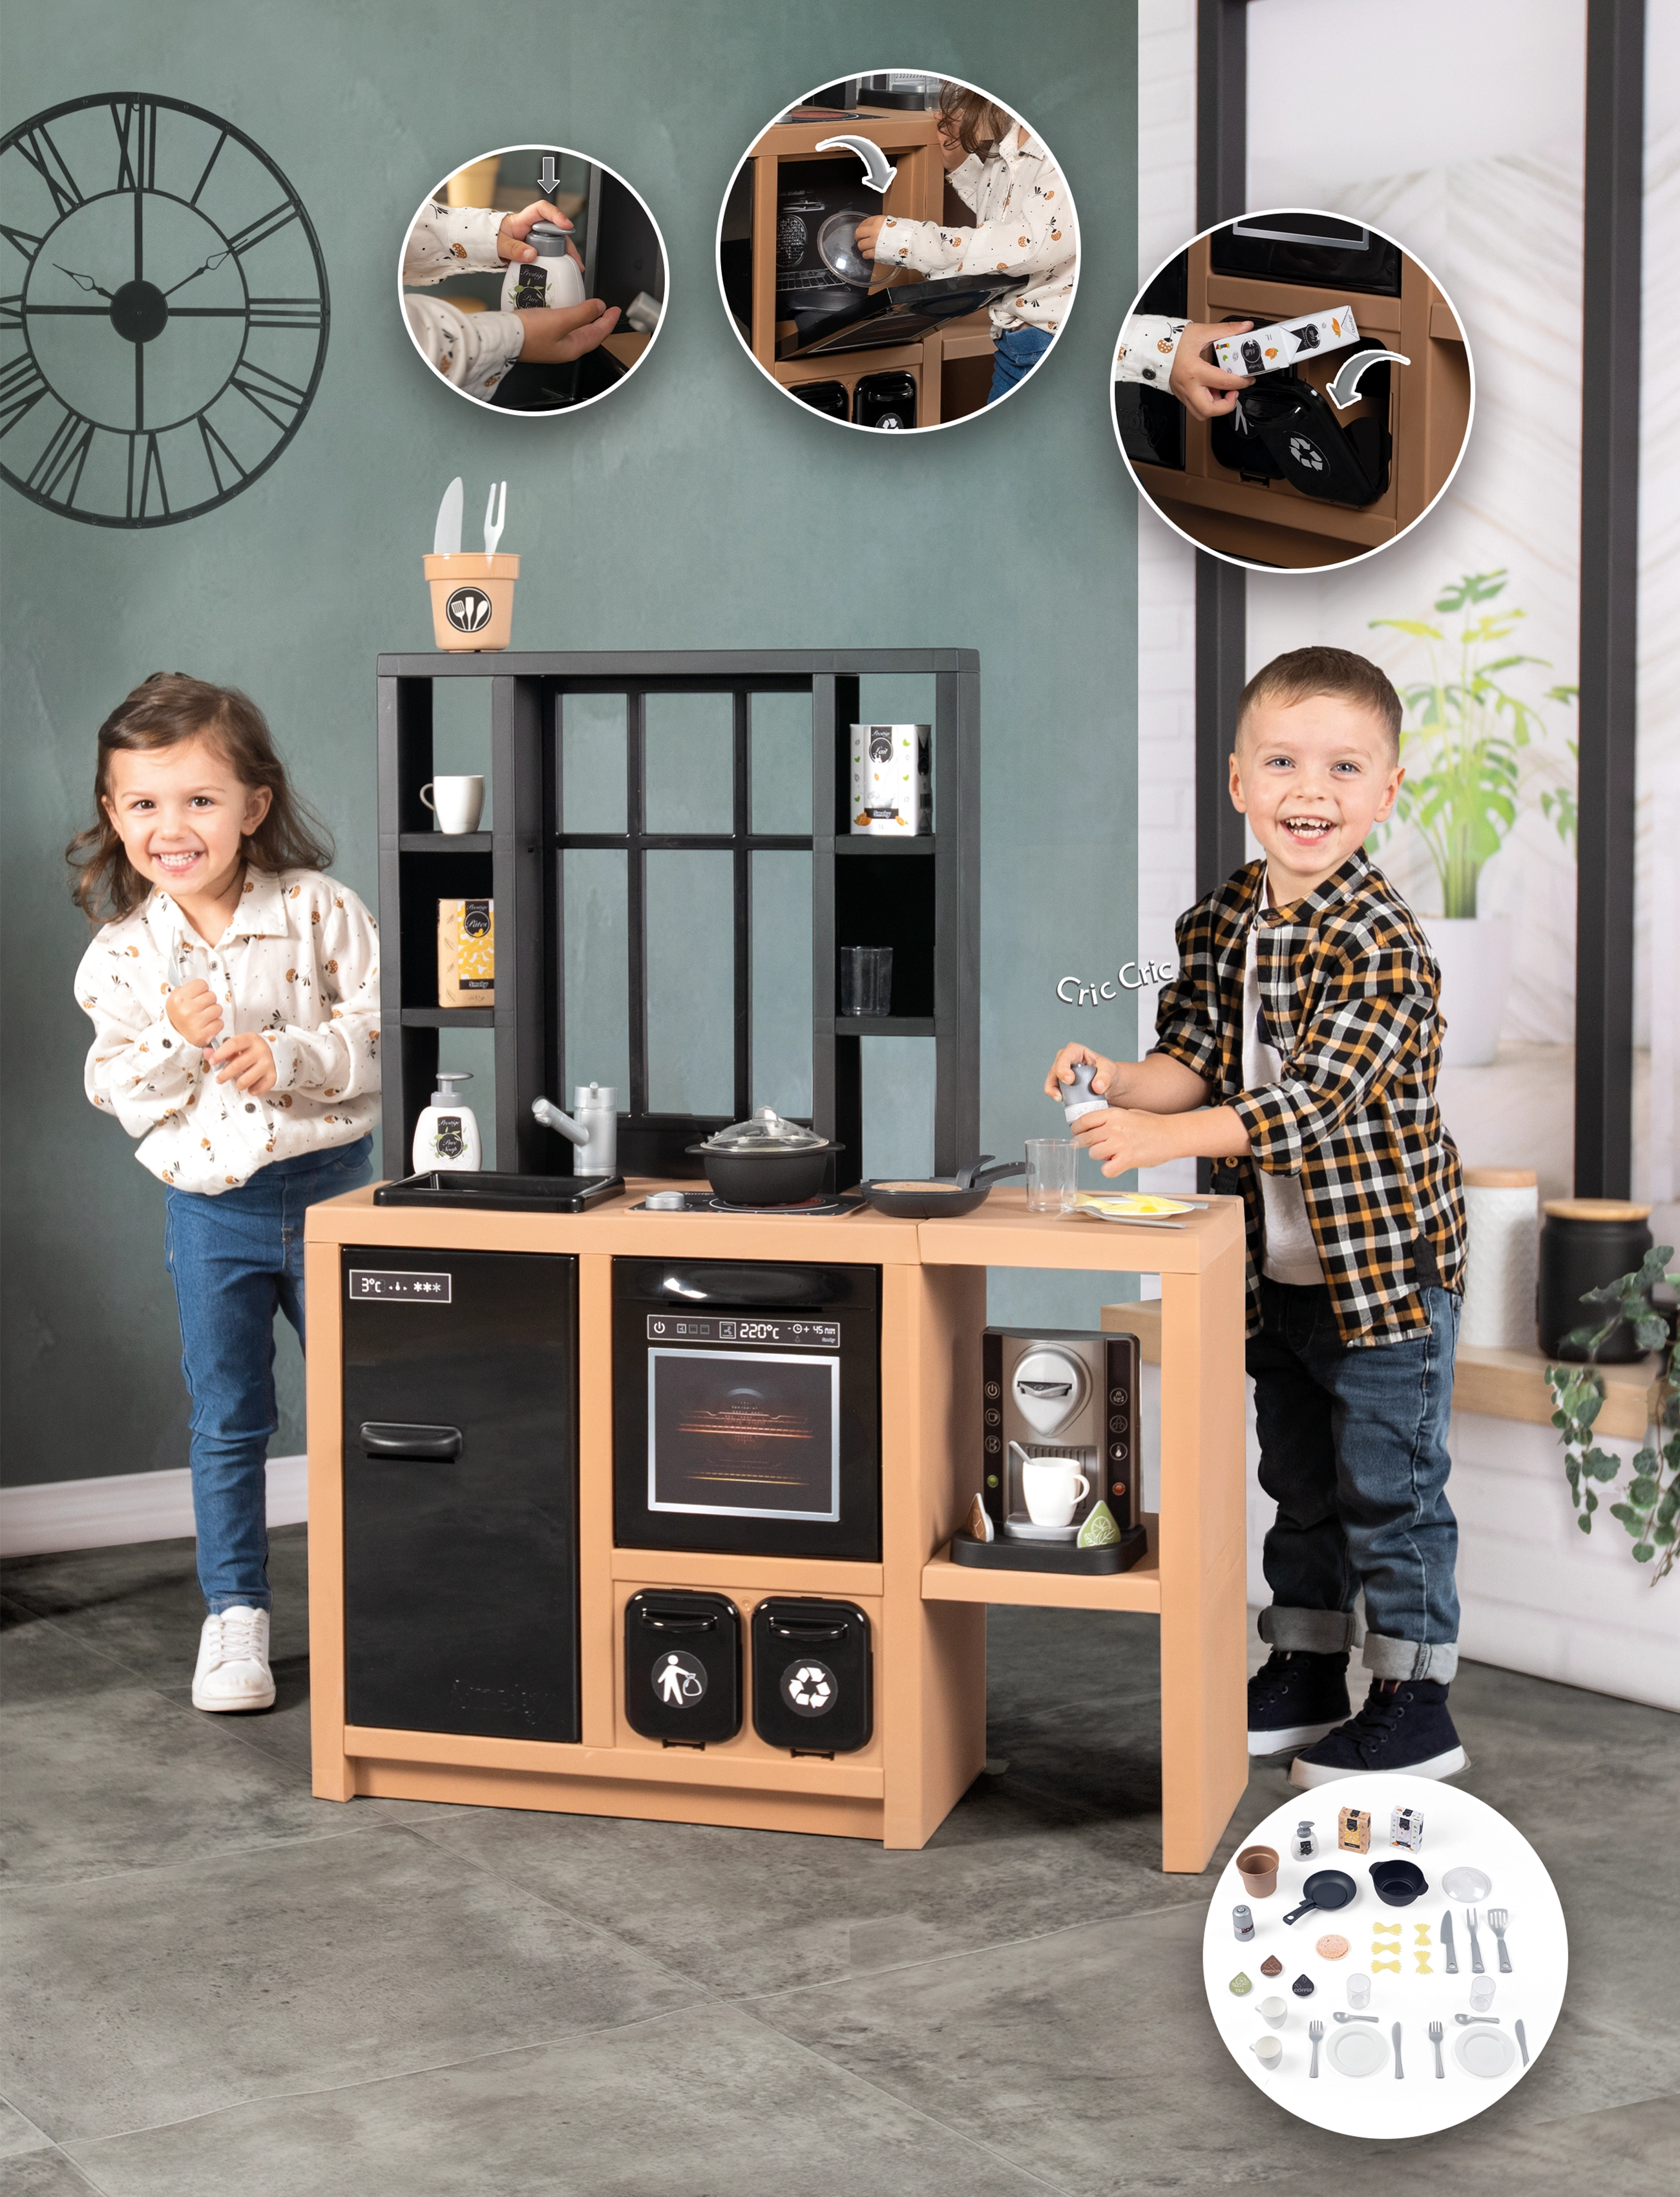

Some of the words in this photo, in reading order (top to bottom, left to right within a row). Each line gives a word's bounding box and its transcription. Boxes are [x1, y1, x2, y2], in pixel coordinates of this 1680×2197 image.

[520, 268, 545, 280] Prestige
[523, 293, 539, 303] Pure
[1116, 405, 1168, 448] moby
[740, 1323, 780, 1340] 220°C
[813, 1325, 824, 1335] 45
